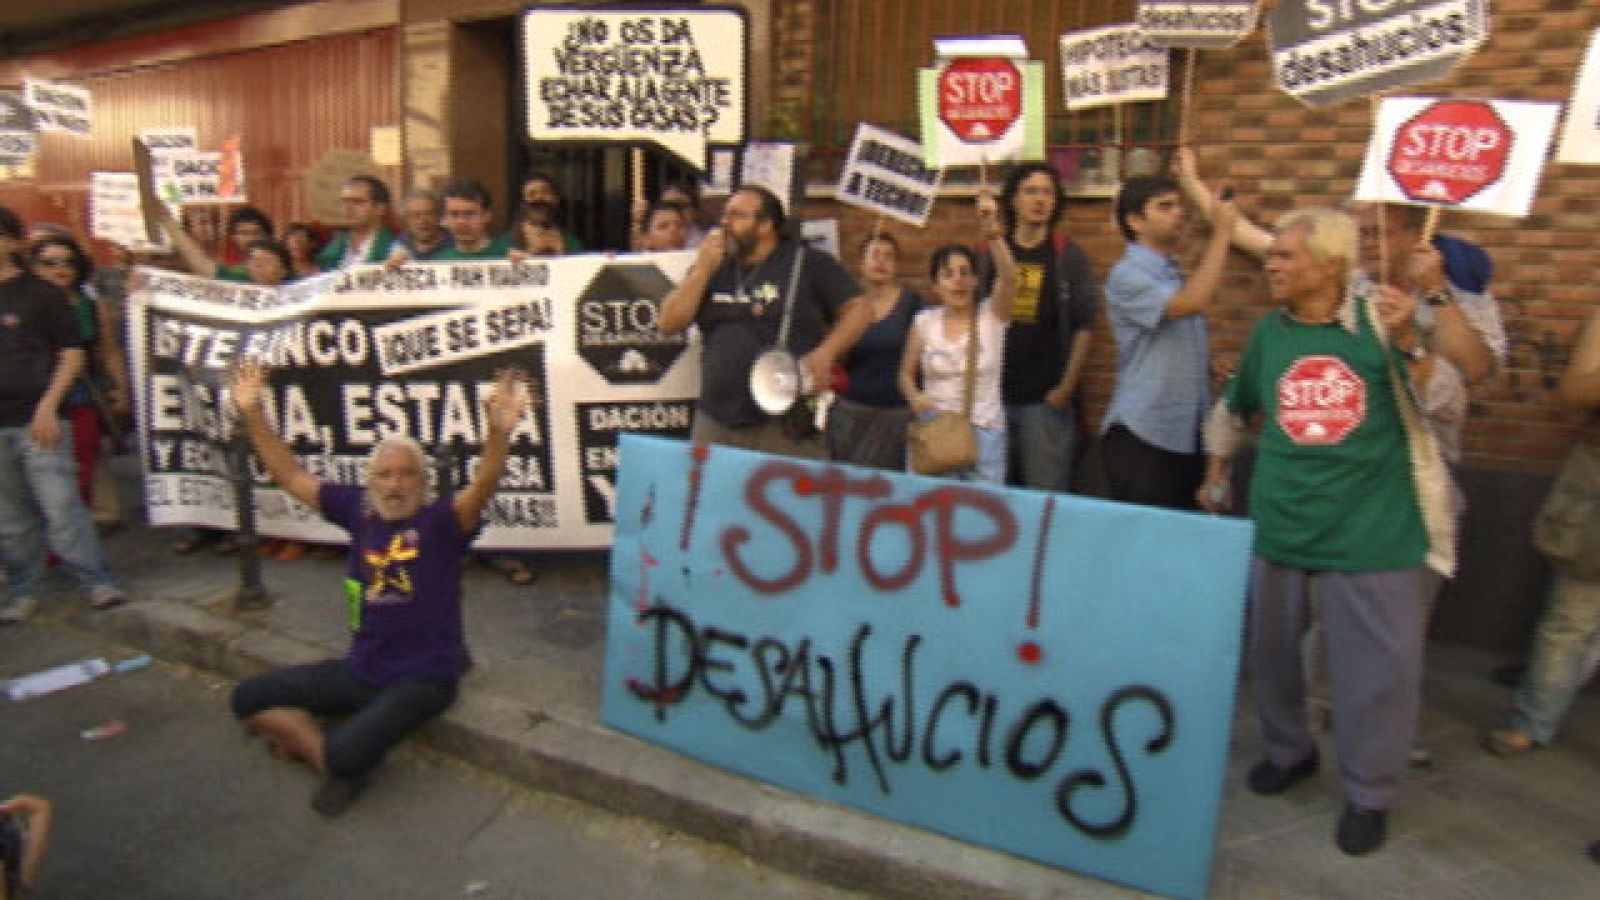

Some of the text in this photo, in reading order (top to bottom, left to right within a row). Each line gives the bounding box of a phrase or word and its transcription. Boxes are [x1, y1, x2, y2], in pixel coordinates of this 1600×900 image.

[620, 18, 656, 43] OS
[660, 18, 695, 45] DA
[945, 71, 1014, 104] STOP
[1402, 124, 1500, 161] STOP
[445, 315, 479, 352] SE
[581, 300, 659, 334] STO
[341, 379, 542, 445] ESTAA
[624, 596, 1176, 842] DESAHUCIOS
